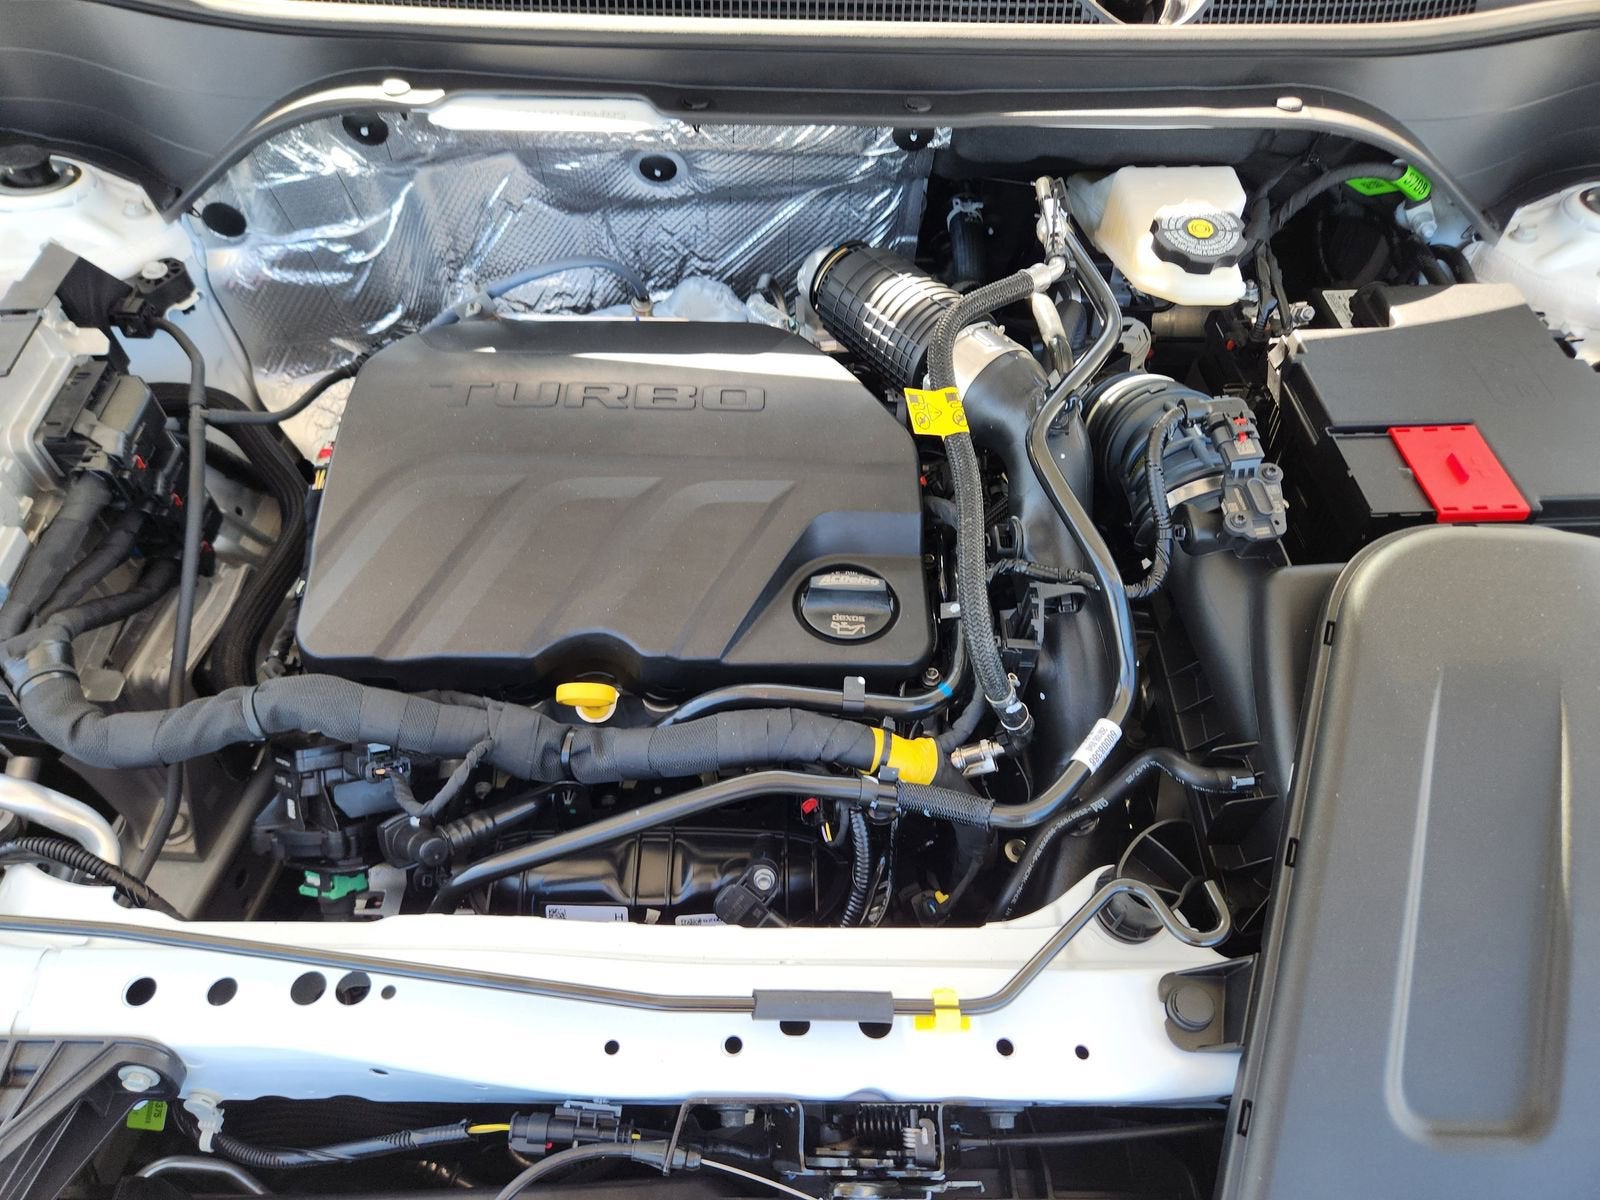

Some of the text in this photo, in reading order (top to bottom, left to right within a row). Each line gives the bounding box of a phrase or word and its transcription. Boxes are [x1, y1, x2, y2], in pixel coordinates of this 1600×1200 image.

[430, 381, 766, 411] TURBO
[818, 574, 880, 586] ACDelco
[831, 613, 865, 622] dexos
